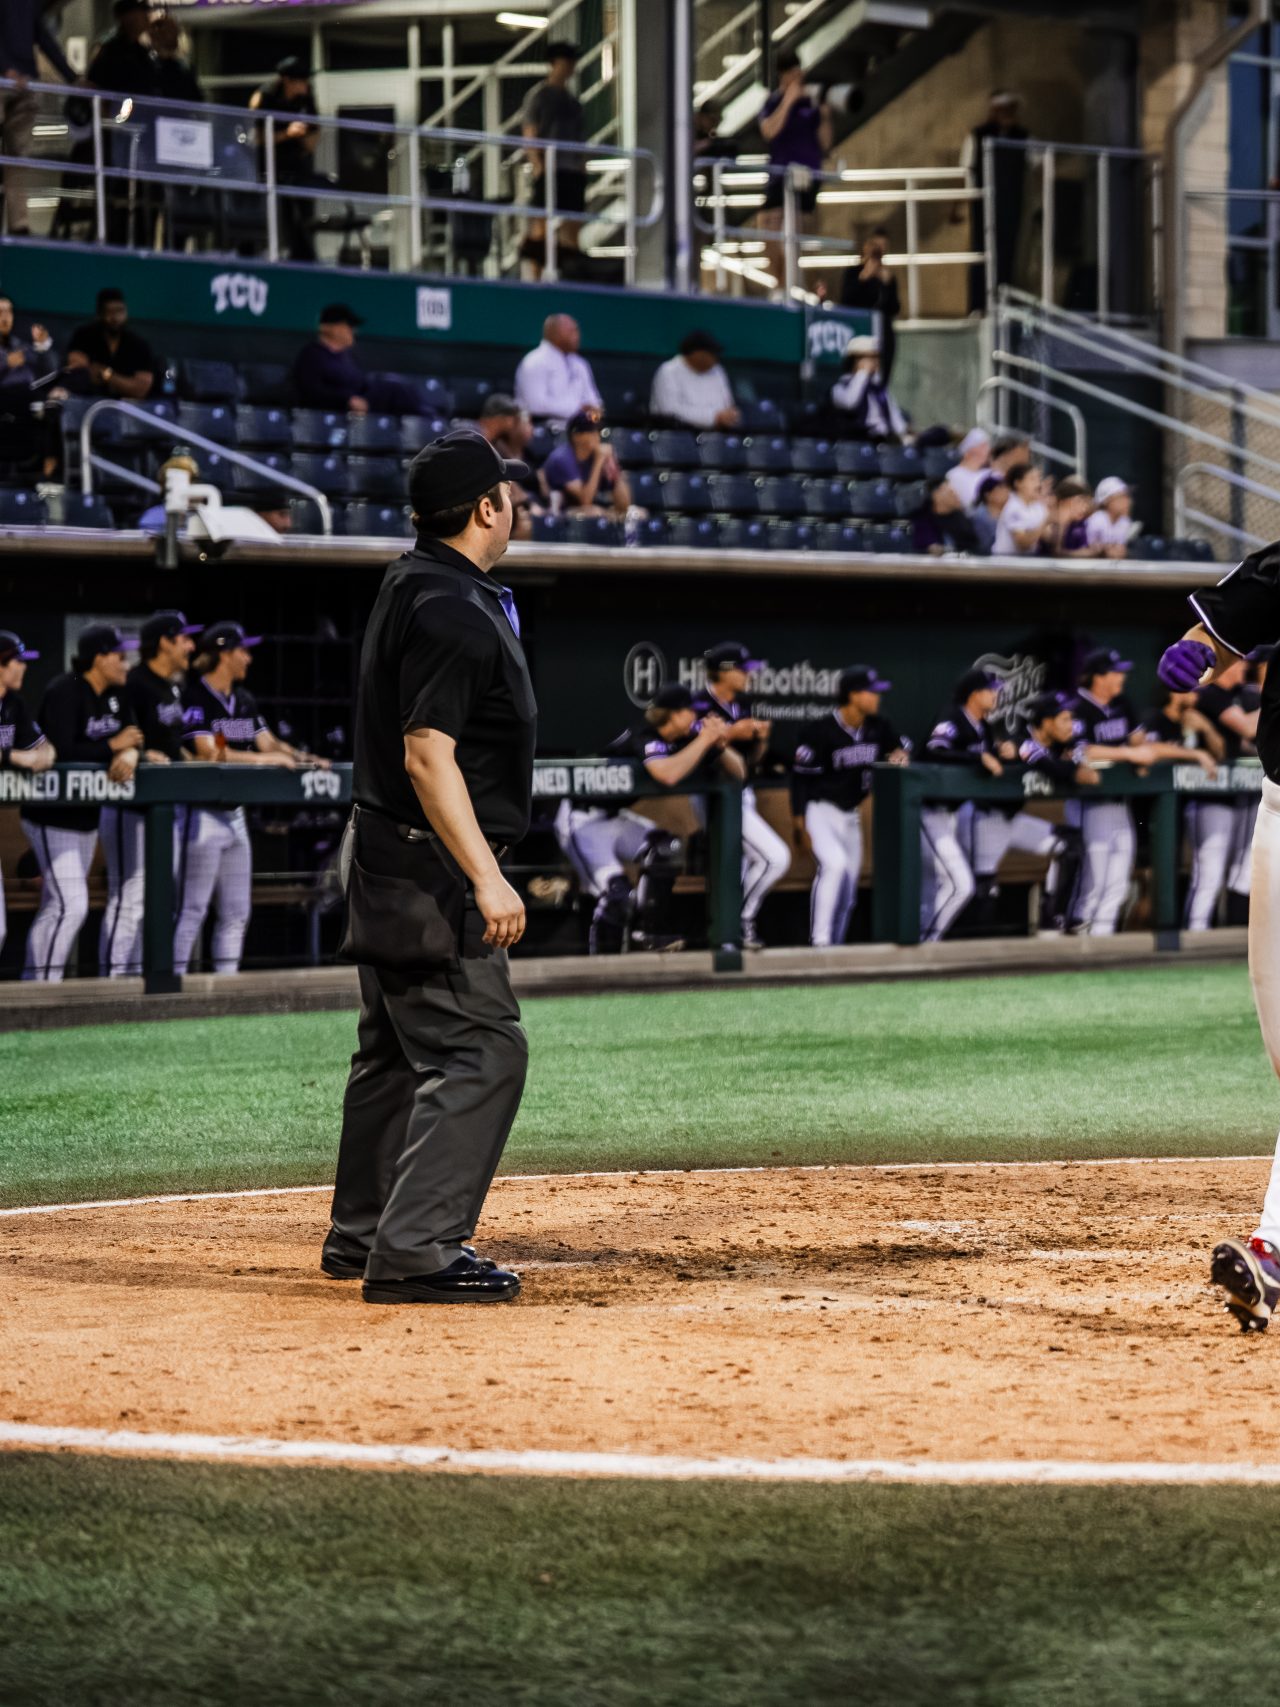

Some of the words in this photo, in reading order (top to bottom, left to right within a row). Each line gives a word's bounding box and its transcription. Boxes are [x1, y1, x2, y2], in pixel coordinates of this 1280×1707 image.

[211, 272, 268, 315] TCU
[808, 320, 854, 358] TCU
[0, 769, 60, 800] RNED
[301, 770, 341, 800] TCU
[532, 766, 570, 795] NED
[573, 764, 634, 795] FROGS
